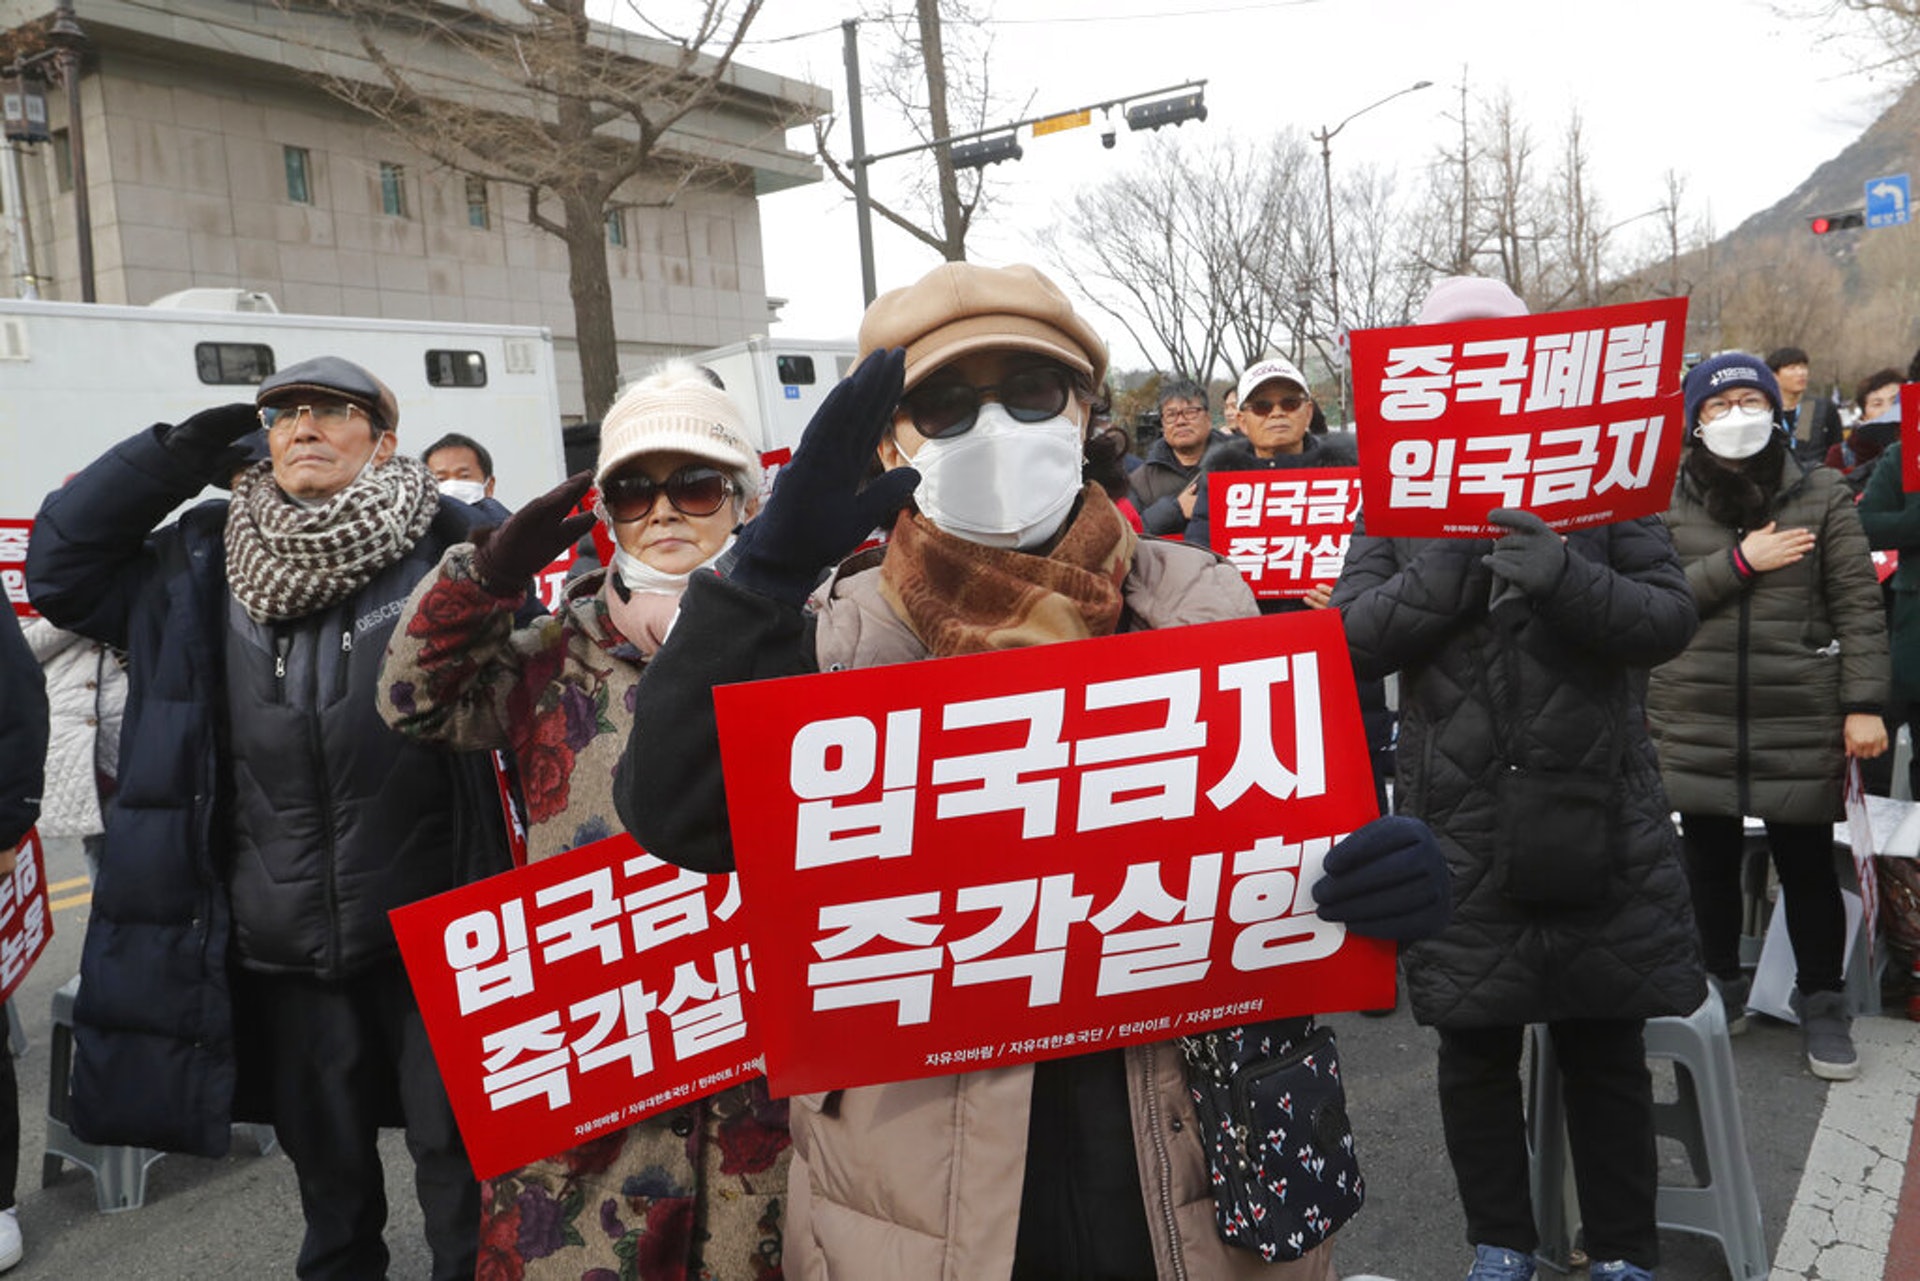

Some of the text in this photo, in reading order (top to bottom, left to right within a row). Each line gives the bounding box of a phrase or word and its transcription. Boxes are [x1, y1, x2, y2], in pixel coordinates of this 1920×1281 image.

[1380, 321, 1665, 421] 중국폐렴
[1388, 415, 1665, 510] 입국금지
[790, 652, 1325, 870] 입국금지
[443, 854, 742, 1017] 입국금
[808, 834, 1347, 1025] 즉각실행
[482, 943, 756, 1111] 즉각실
[925, 1046, 993, 1066] 자유의바람
[1009, 1027, 1104, 1054] 자유대한호국단
[1118, 1017, 1171, 1037] 턴라이트
[1185, 998, 1263, 1024] 자유법치센터
